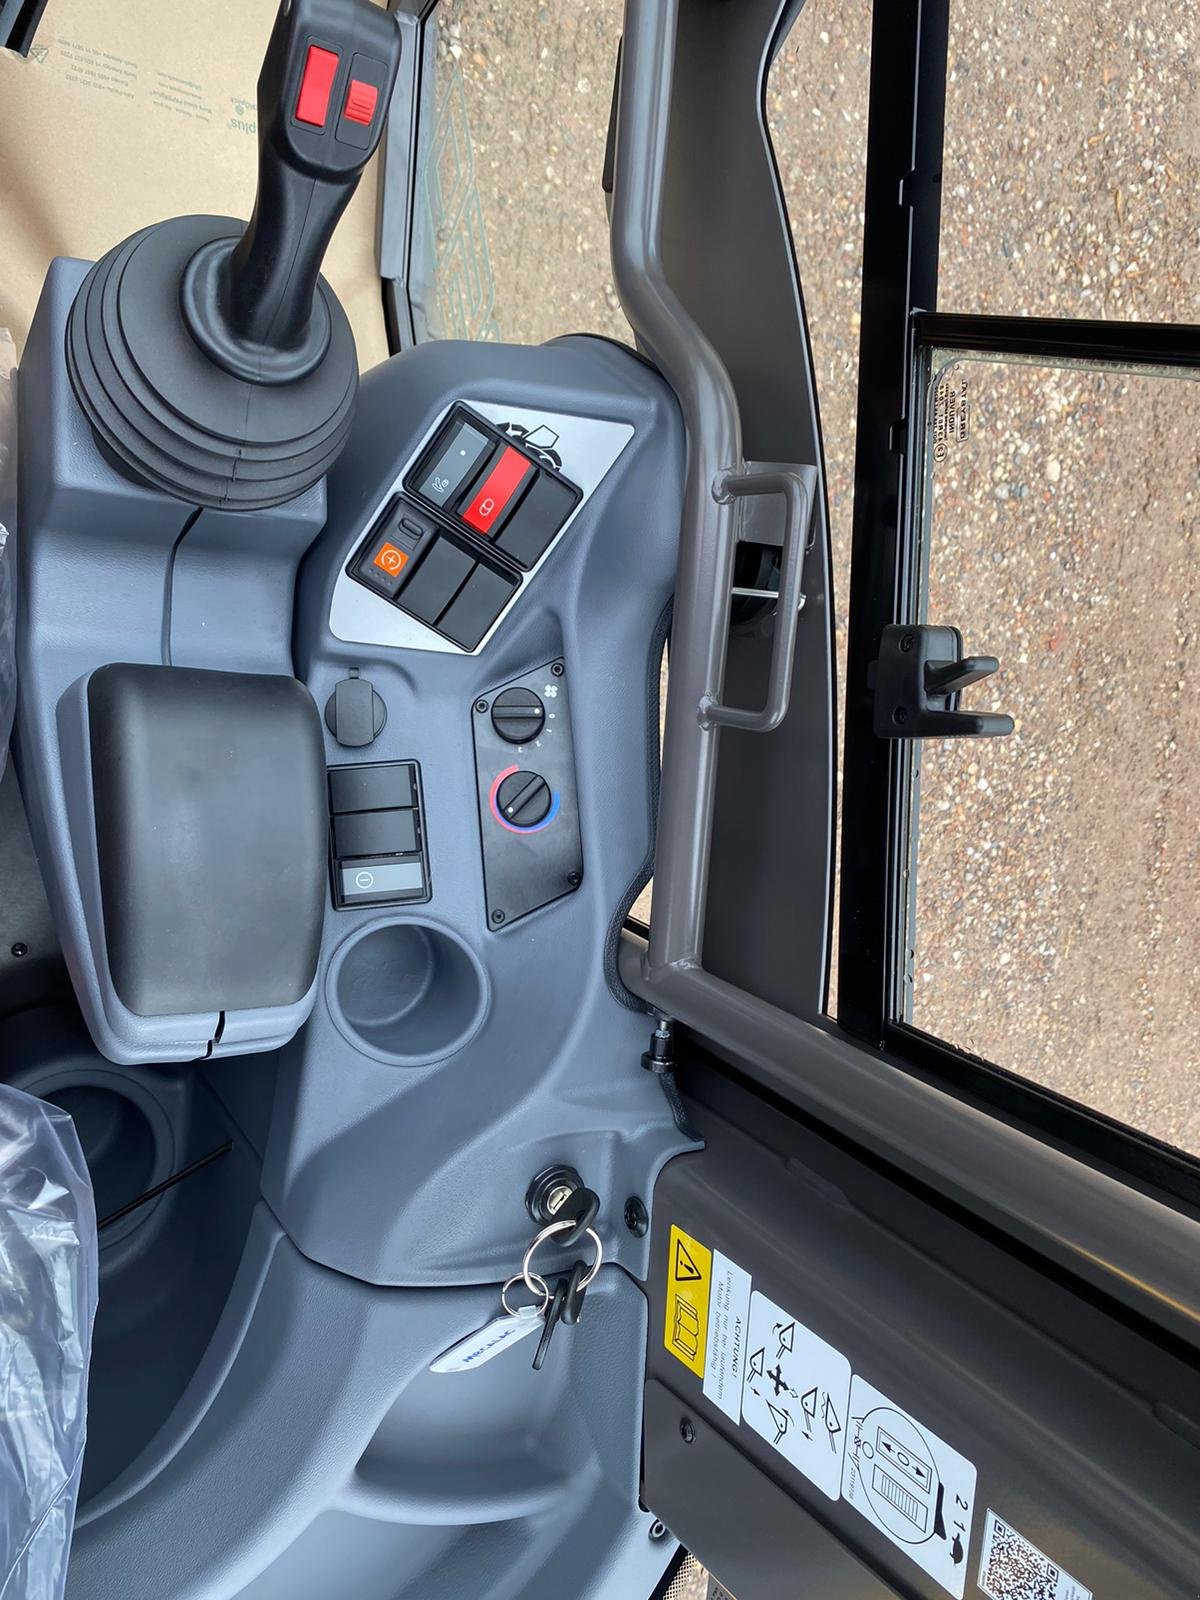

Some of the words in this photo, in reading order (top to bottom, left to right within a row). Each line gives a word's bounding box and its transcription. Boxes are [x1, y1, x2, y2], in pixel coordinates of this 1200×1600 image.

[716, 1281, 724, 1308] Motor
[722, 1270, 734, 1312] Lenkung
[721, 1334, 729, 1348] bei
[731, 1315, 742, 1378] ACHTUNG!
[717, 1352, 727, 1400] laufendem
[955, 1494, 969, 1512] 2
[953, 1520, 967, 1533] 1
